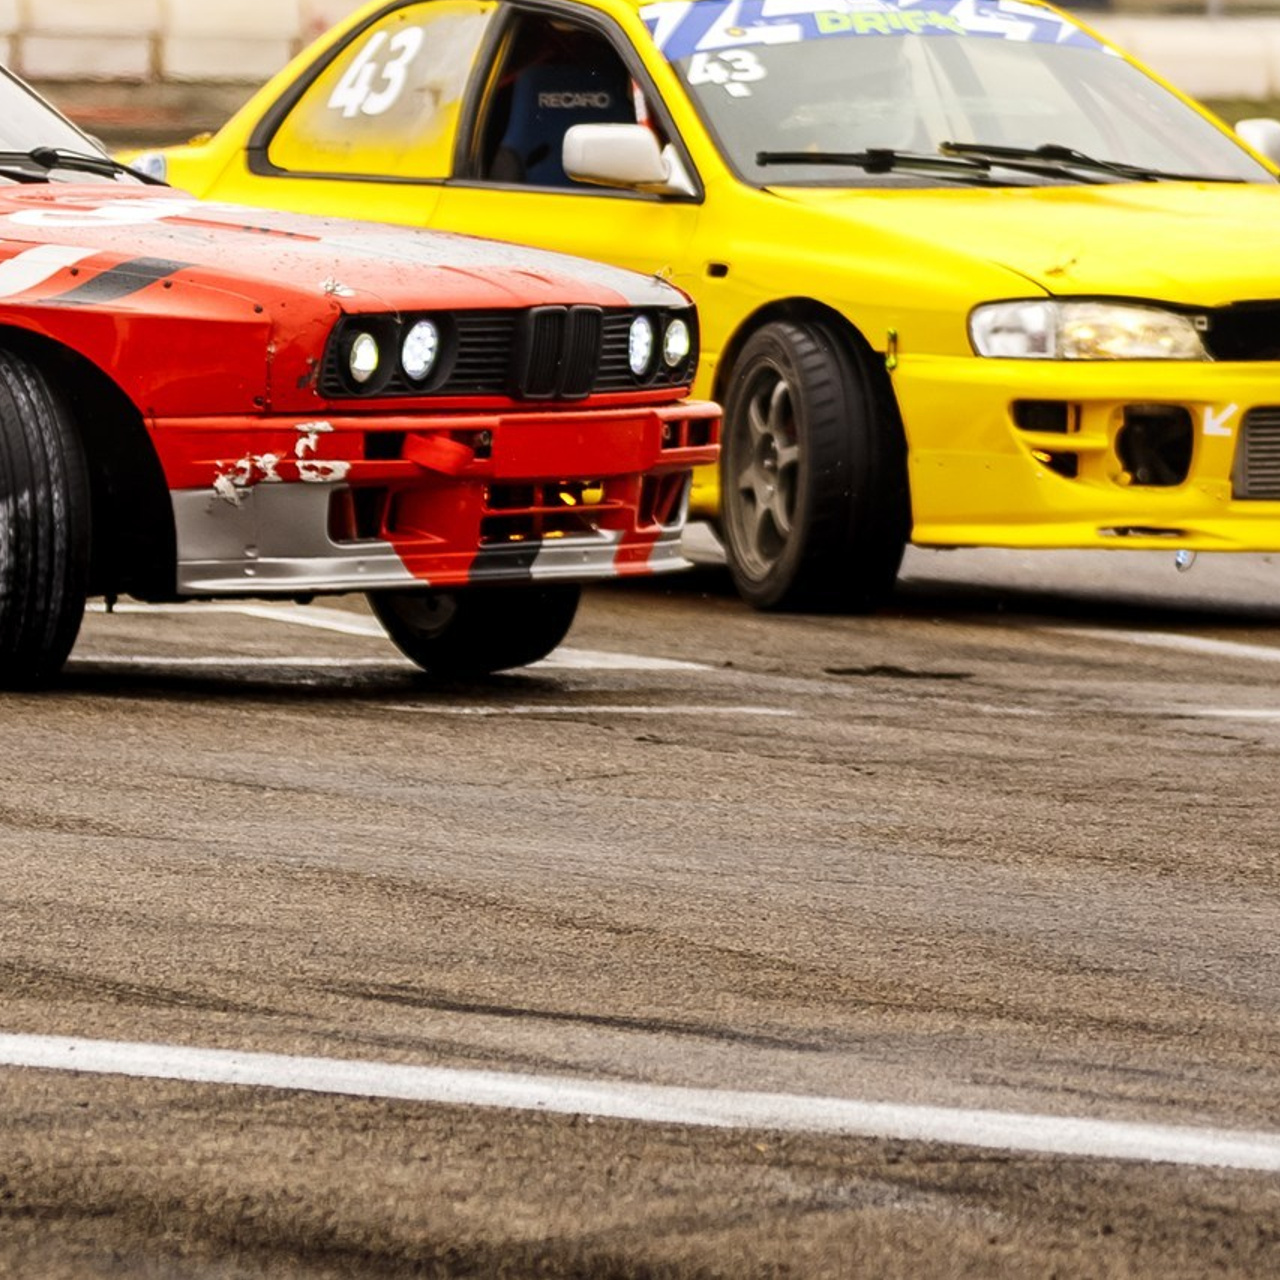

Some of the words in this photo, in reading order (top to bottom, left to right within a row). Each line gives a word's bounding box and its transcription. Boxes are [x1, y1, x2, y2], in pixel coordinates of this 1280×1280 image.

[327, 26, 425, 118] 43
[687, 48, 768, 86] 43
[538, 92, 609, 109] RECARO
